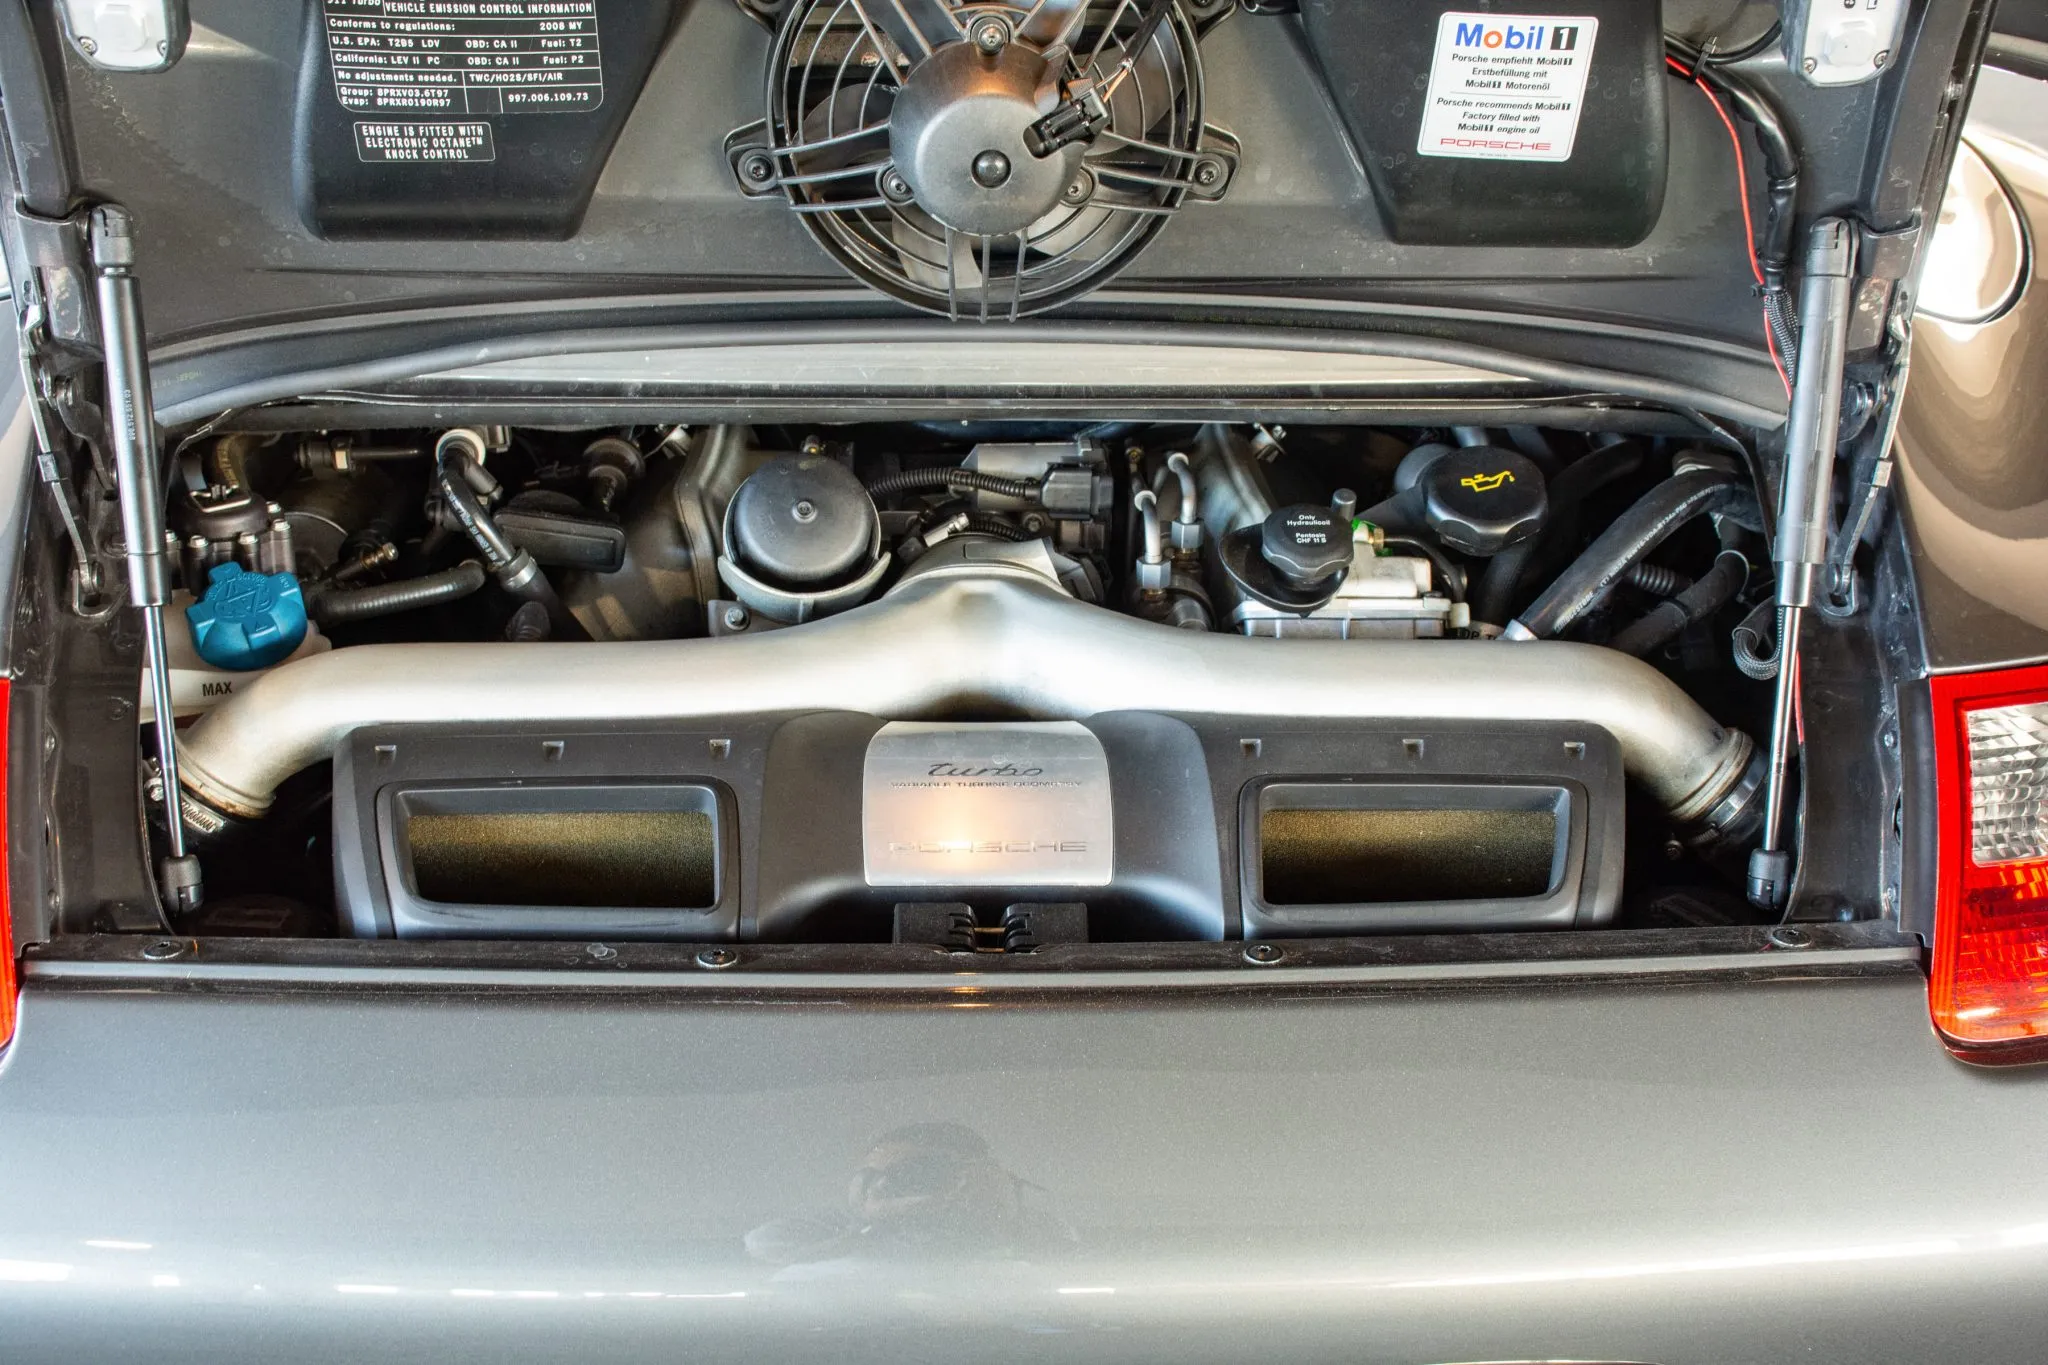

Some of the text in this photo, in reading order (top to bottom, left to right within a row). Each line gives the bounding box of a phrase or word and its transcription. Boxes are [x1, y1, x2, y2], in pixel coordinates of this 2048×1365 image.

[385, 2, 592, 14] VEHICLE EMISSION CONTROL INFORMATION
[330, 18, 455, 31] Conforms to regulations:
[540, 22, 582, 30] 2008 MY
[332, 36, 440, 48] U.S. EPA: T2B5 LDV
[1455, 23, 1544, 50] Mobil
[465, 40, 490, 48] OBD:
[493, 40, 507, 48] CA
[541, 39, 582, 48] Fuel: T2
[335, 53, 387, 64] California:
[391, 56, 409, 64] LEV
[427, 56, 440, 65] PC
[467, 57, 492, 65] OBD:
[496, 57, 509, 65] CA
[543, 55, 584, 64] Fuel: P2
[1452, 53, 1488, 63] Porsche
[1492, 57, 1533, 65] empfiehlt
[337, 71, 457, 82] No adjustments needed.
[1472, 67, 1547, 78] Erstbefüllung mit
[340, 87, 373, 97] Group:
[1506, 82, 1550, 91] Motorenöl
[342, 97, 369, 106] Evap:
[508, 92, 589, 102] 997.006.109.73
[1437, 97, 1473, 107] Porsche
[1475, 101, 1532, 110] recommends
[1463, 112, 1540, 122] Factory filled with
[362, 125, 483, 136] ENGINE IS FITTED WITH
[1497, 126, 1526, 135] engine
[365, 137, 428, 148] ELECTRONIC
[1440, 138, 1552, 151] PORSCHE
[385, 149, 469, 159] KNOCK CONTROL
[202, 682, 232, 696] MAX
[927, 762, 1043, 777] turbo
